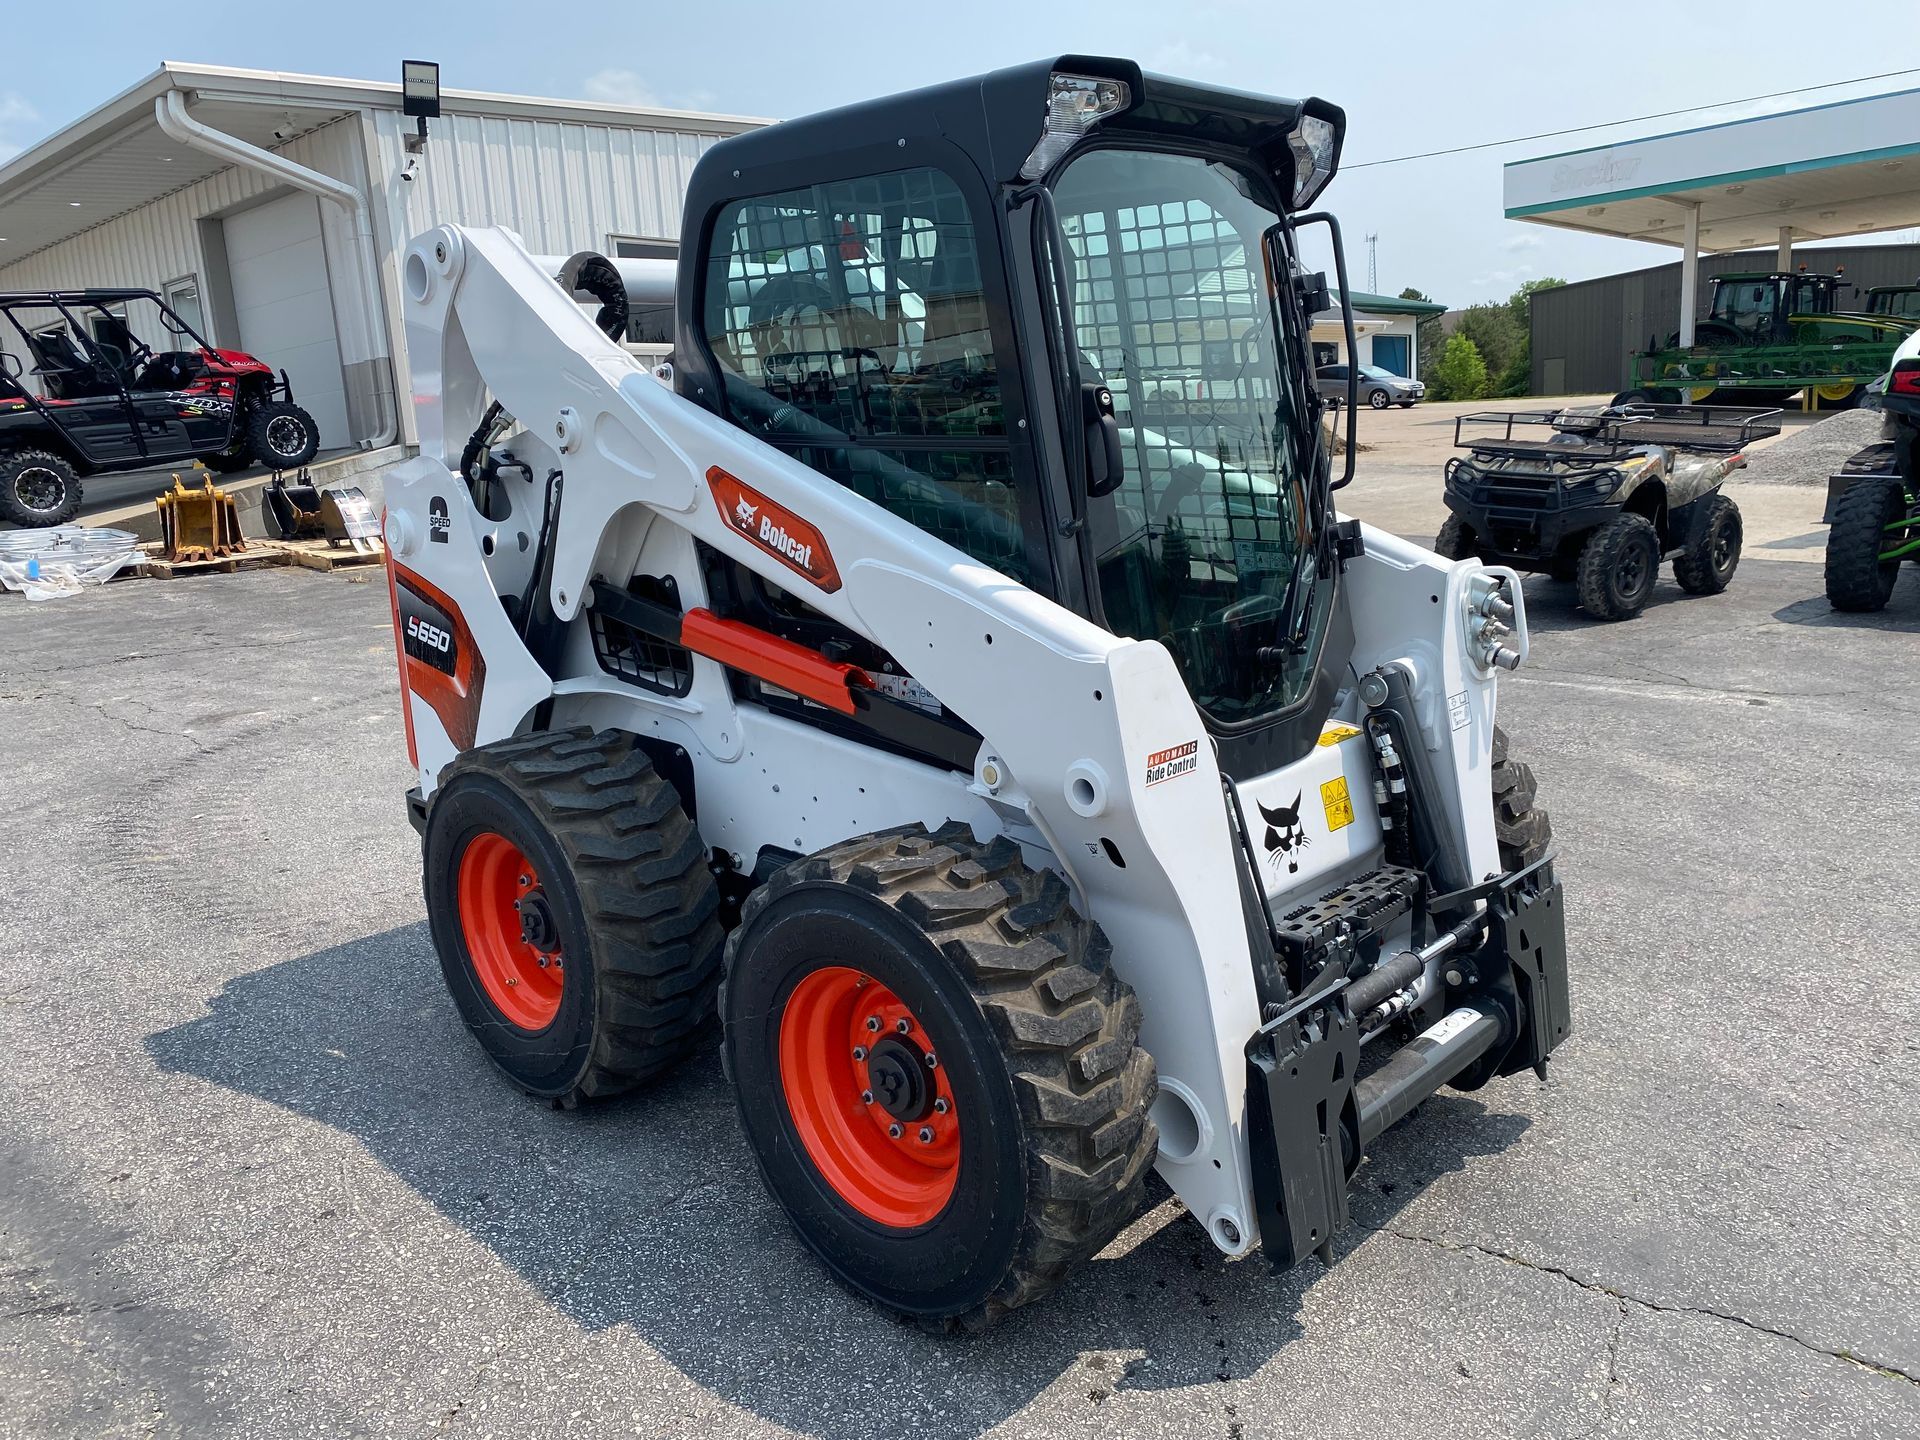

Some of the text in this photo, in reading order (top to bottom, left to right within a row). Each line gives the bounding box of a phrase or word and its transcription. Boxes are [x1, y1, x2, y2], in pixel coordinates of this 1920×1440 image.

[429, 495, 449, 544] 2
[430, 516, 450, 528] SPEED
[759, 515, 812, 569] Bobcat
[407, 615, 451, 653] S650
[1146, 754, 1197, 784] Ride Control
[1148, 742, 1196, 767] AUTOMATIC
